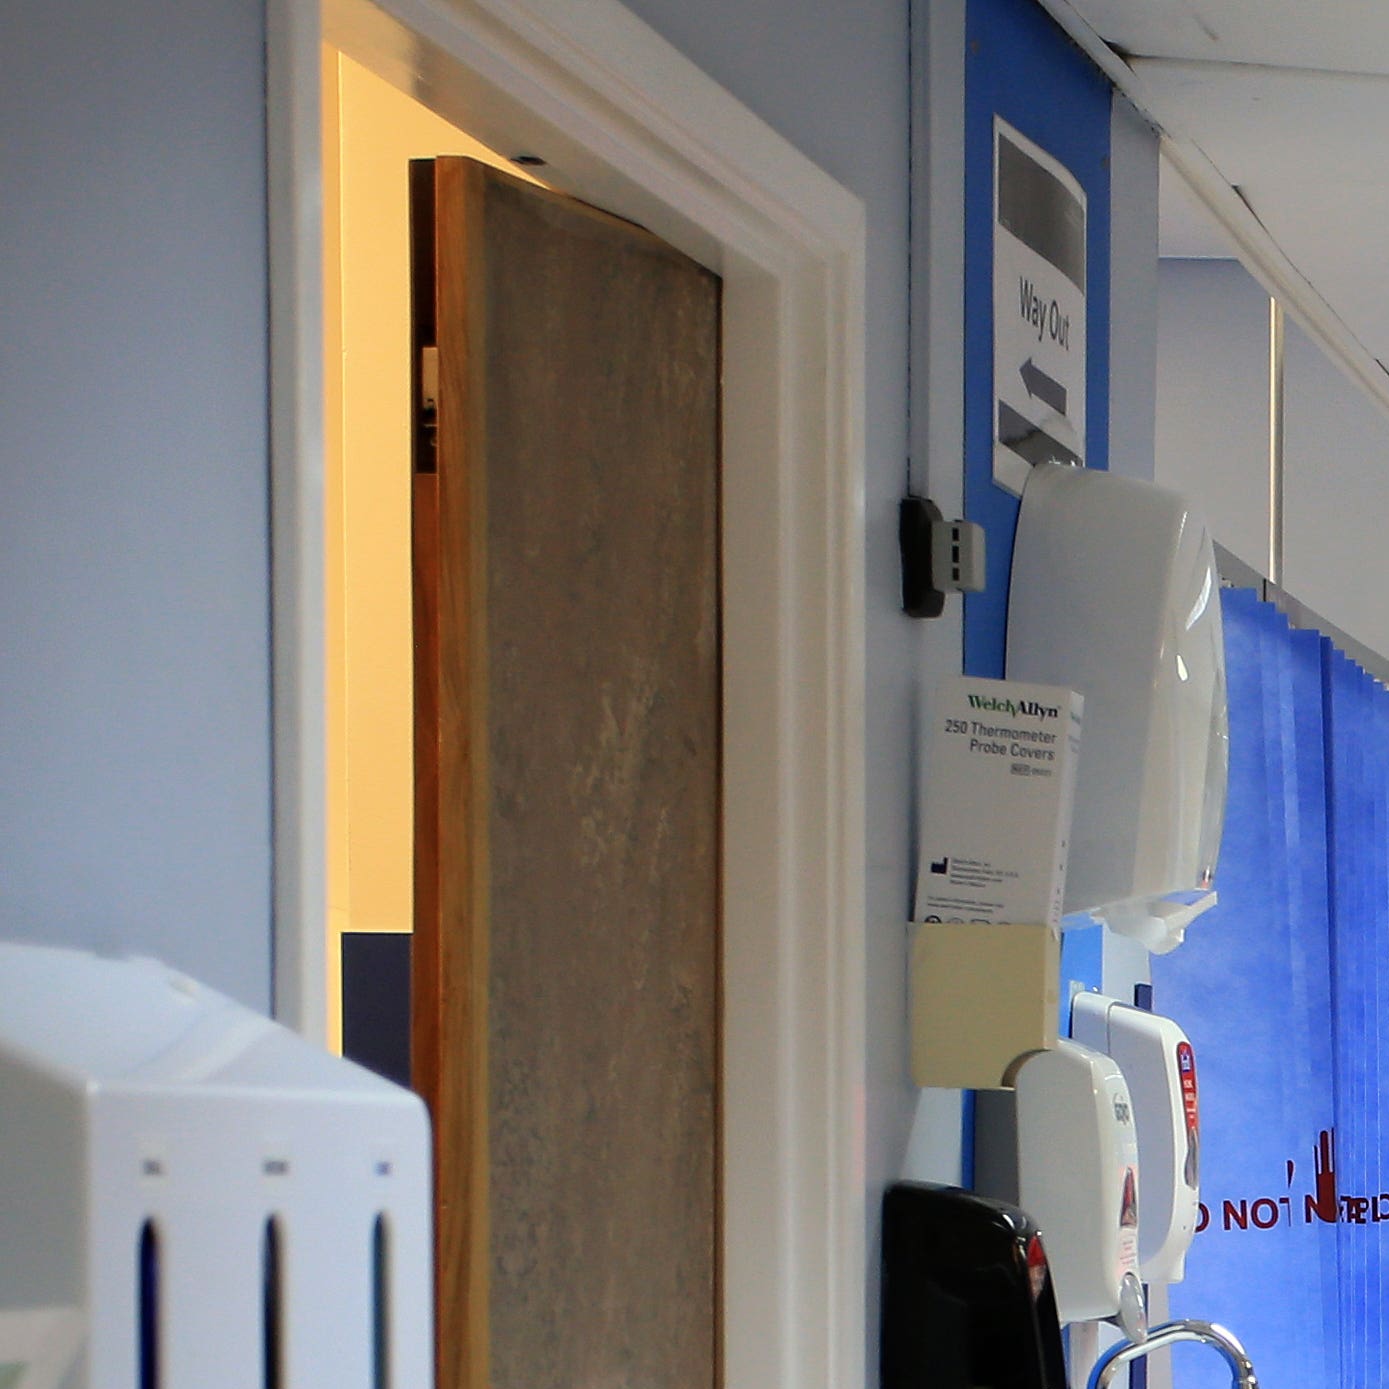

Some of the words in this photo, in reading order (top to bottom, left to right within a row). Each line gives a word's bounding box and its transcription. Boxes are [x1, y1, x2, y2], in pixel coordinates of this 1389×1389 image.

[1019, 275, 1047, 342] Way
[1049, 300, 1070, 350] Out
[945, 719, 968, 734] 250
[971, 721, 1057, 744] Thermometer
[970, 738, 1007, 755] Probe
[1010, 744, 1055, 760] Covers
